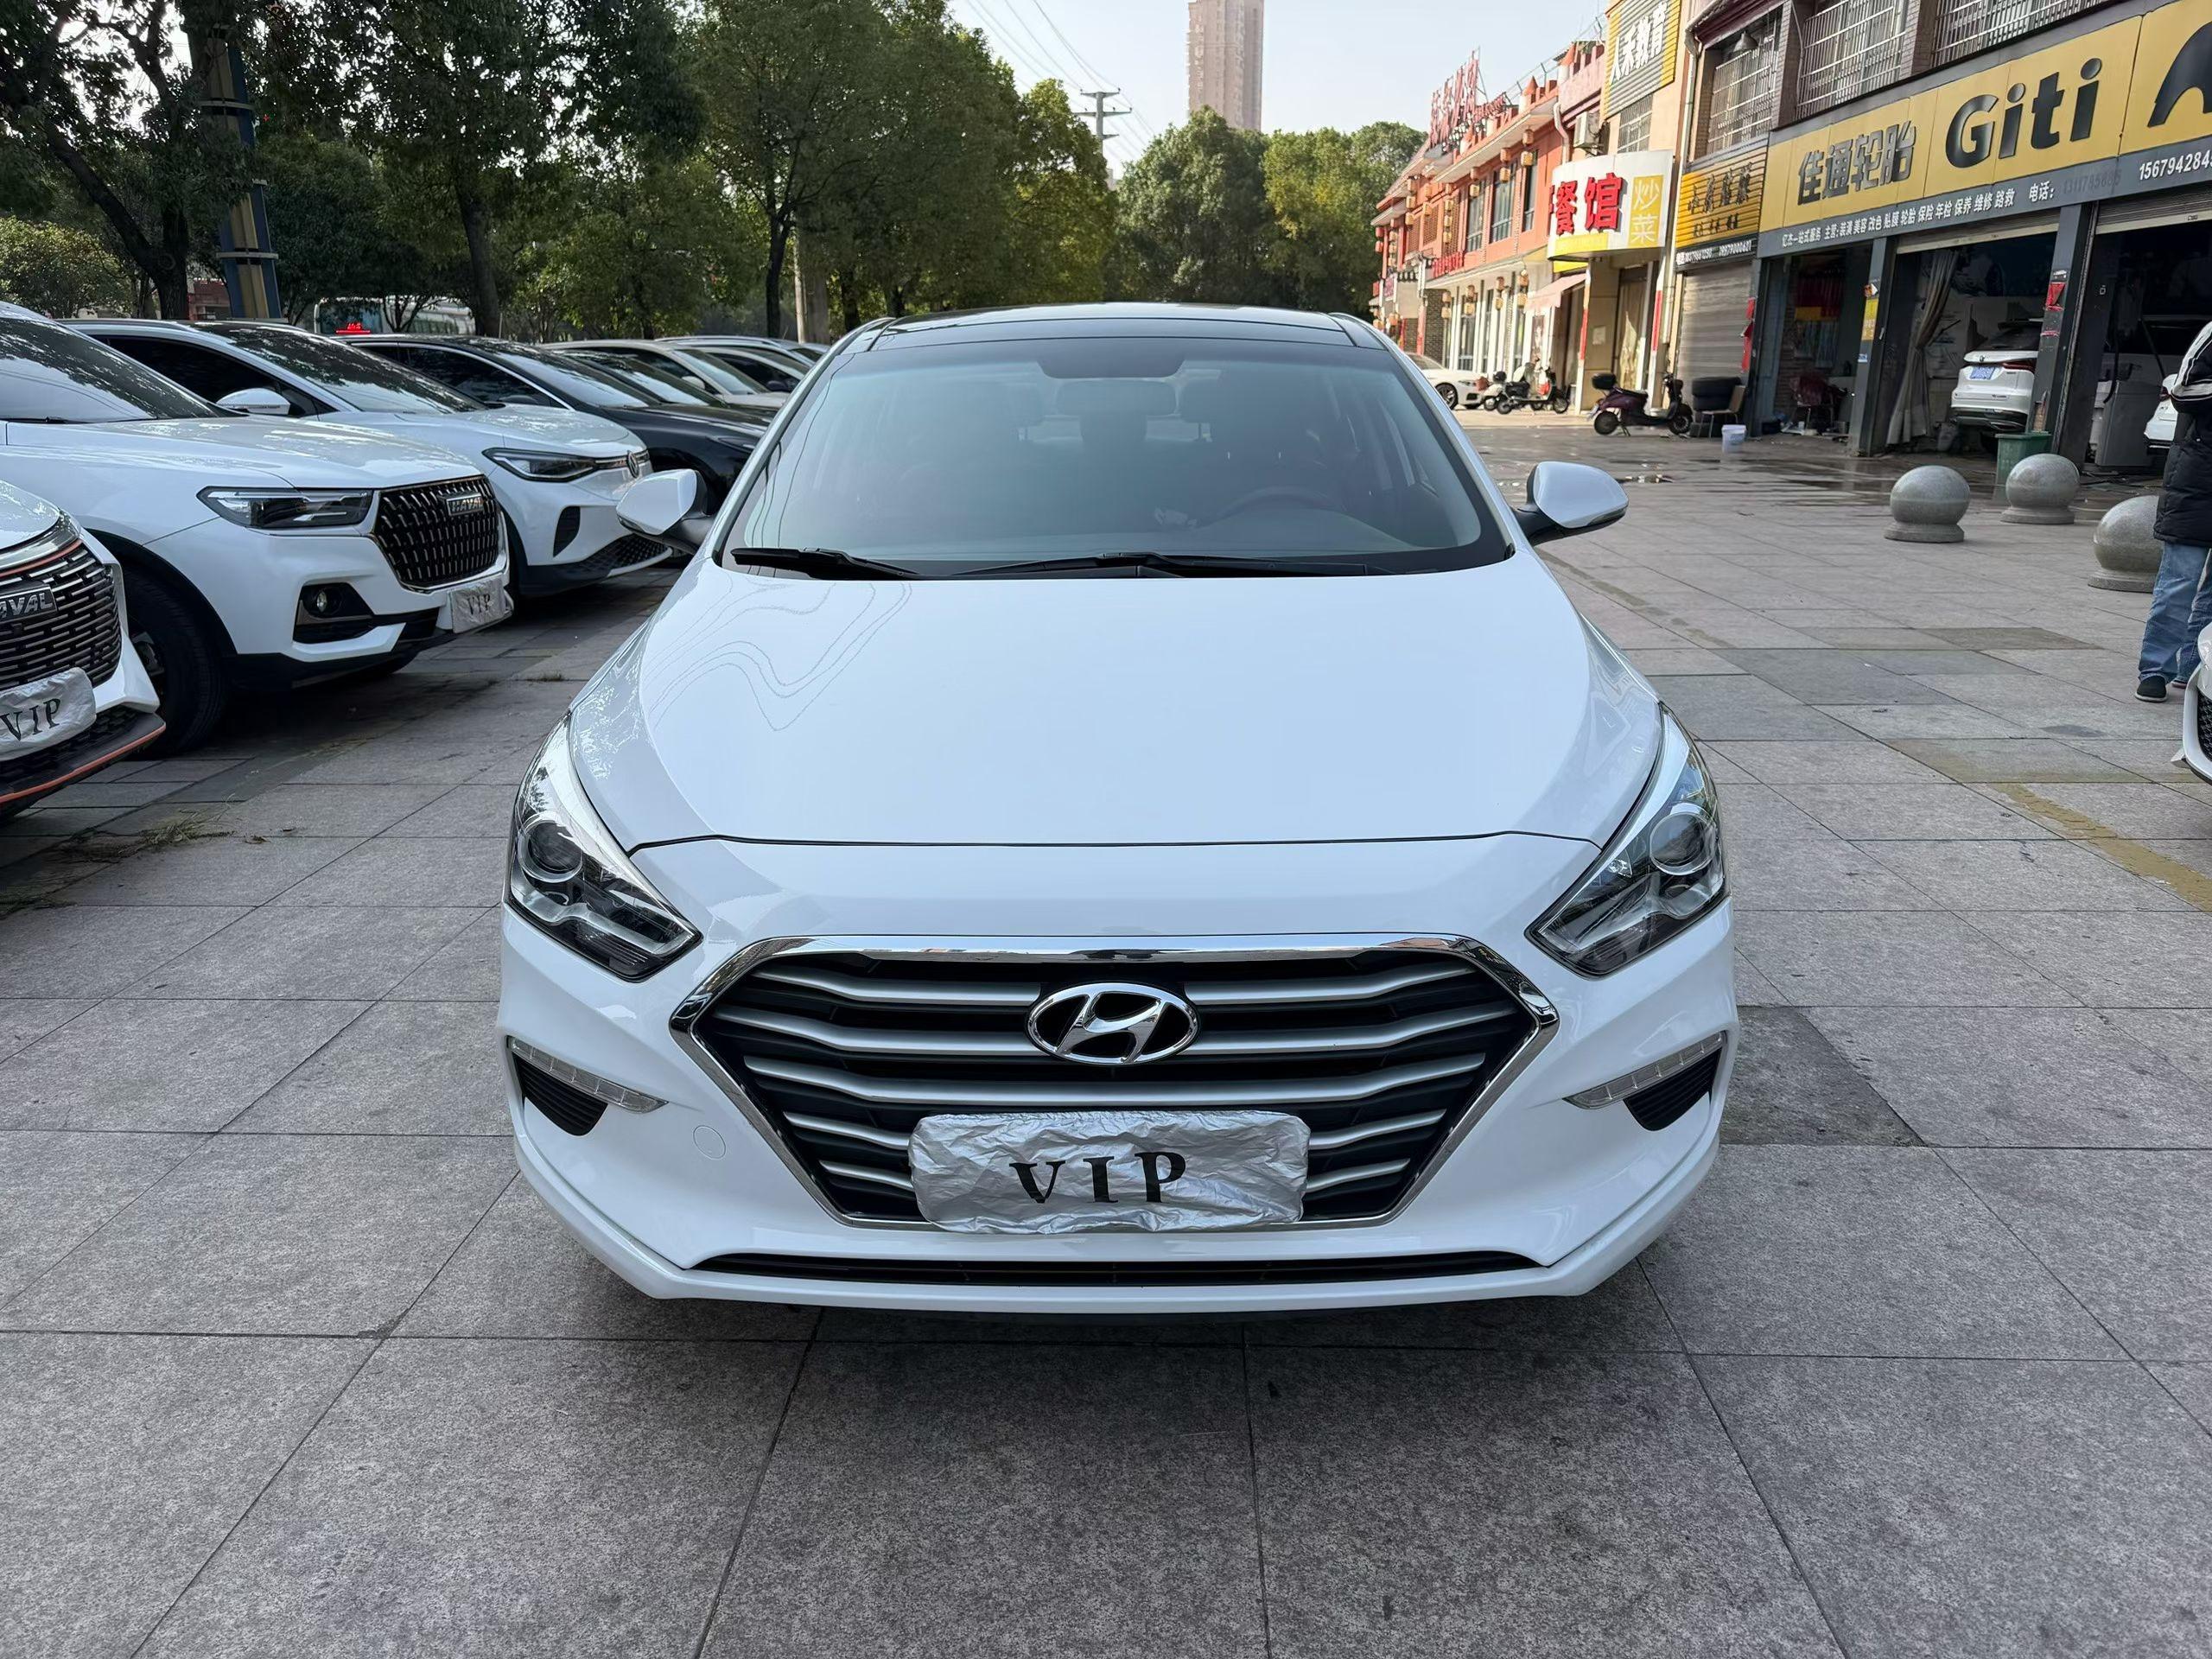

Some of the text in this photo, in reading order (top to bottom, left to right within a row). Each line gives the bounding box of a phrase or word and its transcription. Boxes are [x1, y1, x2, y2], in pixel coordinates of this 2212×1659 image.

[1945, 57, 2103, 168] Giti
[1797, 120, 1916, 206] 佳通轮胎
[2139, 149, 2212, 181] 156794284
[1550, 172, 1624, 236] 餐馆
[1630, 178, 1660, 244] 炒菜
[467, 593, 491, 615] VIP
[0, 698, 61, 741] VIP
[1009, 1152, 1186, 1204] VIP
